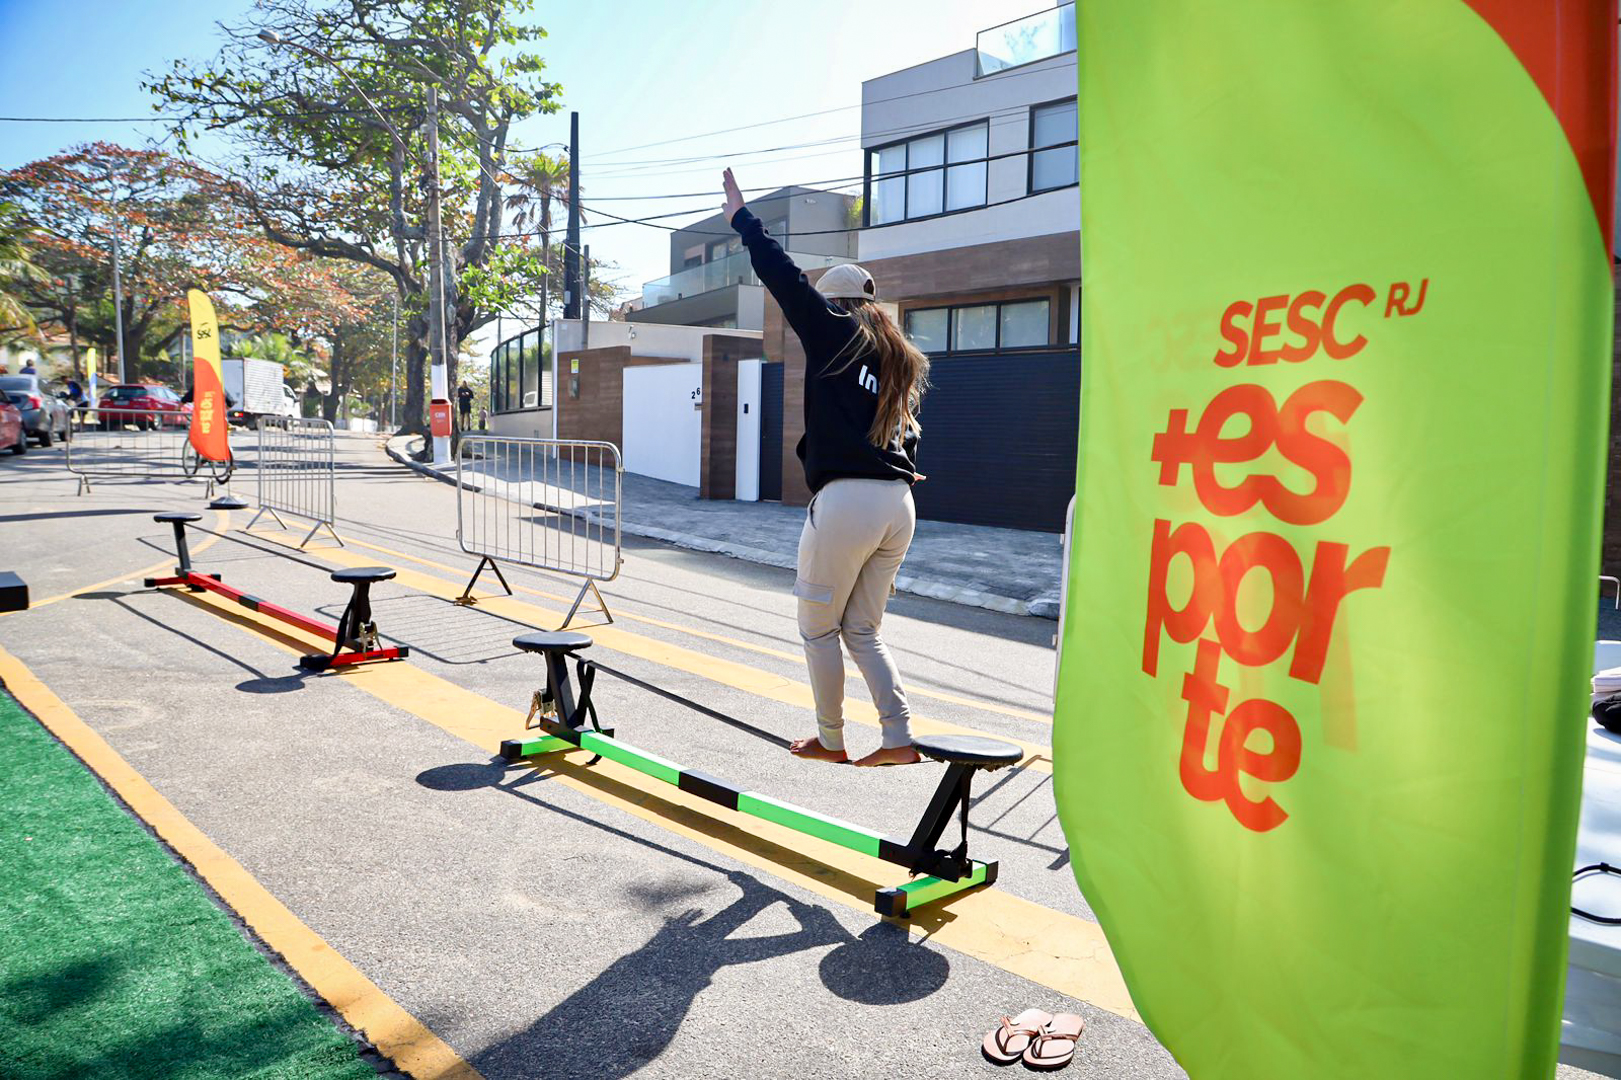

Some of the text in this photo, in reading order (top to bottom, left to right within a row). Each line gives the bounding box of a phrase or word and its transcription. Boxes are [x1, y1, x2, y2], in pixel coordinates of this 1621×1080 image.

[1213, 278, 1429, 368] SESC RJ
[1142, 518, 1391, 685] por
[1178, 637, 1302, 834] te
